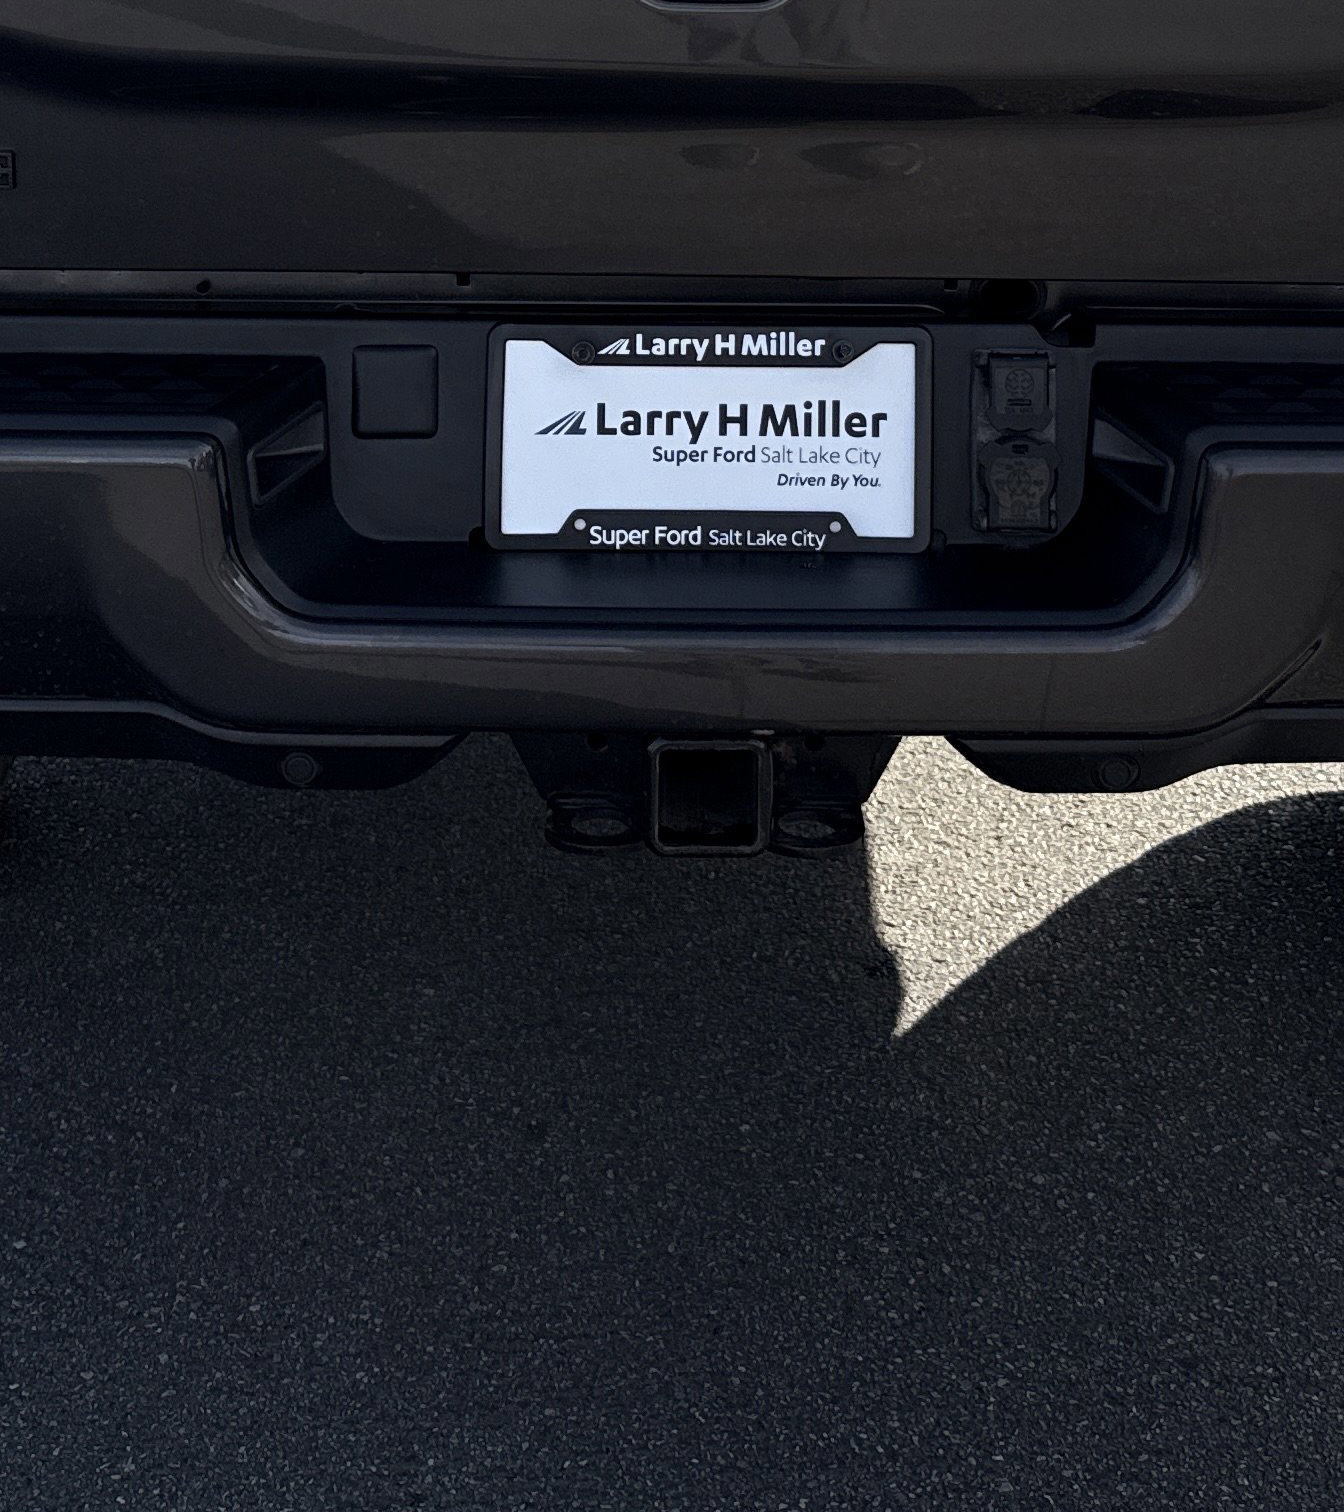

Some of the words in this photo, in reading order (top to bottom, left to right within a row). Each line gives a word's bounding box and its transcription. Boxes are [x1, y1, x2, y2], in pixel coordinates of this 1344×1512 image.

[636, 333, 709, 361] Larry
[715, 333, 735, 356] H
[741, 331, 826, 356] Miller
[596, 402, 709, 445] Larry
[718, 403, 748, 437] H
[758, 399, 888, 438] Miller
[652, 445, 708, 467] Super
[713, 445, 756, 463] Ford
[760, 444, 794, 464] Salt
[799, 445, 841, 464] Lake
[845, 446, 882, 468] City
[777, 472, 826, 487] Driven
[830, 473, 850, 490] By
[589, 525, 649, 550] Super
[654, 525, 702, 546] Ford
[709, 528, 743, 546] Salt
[747, 529, 788, 547] Lake
[792, 529, 827, 551] City
